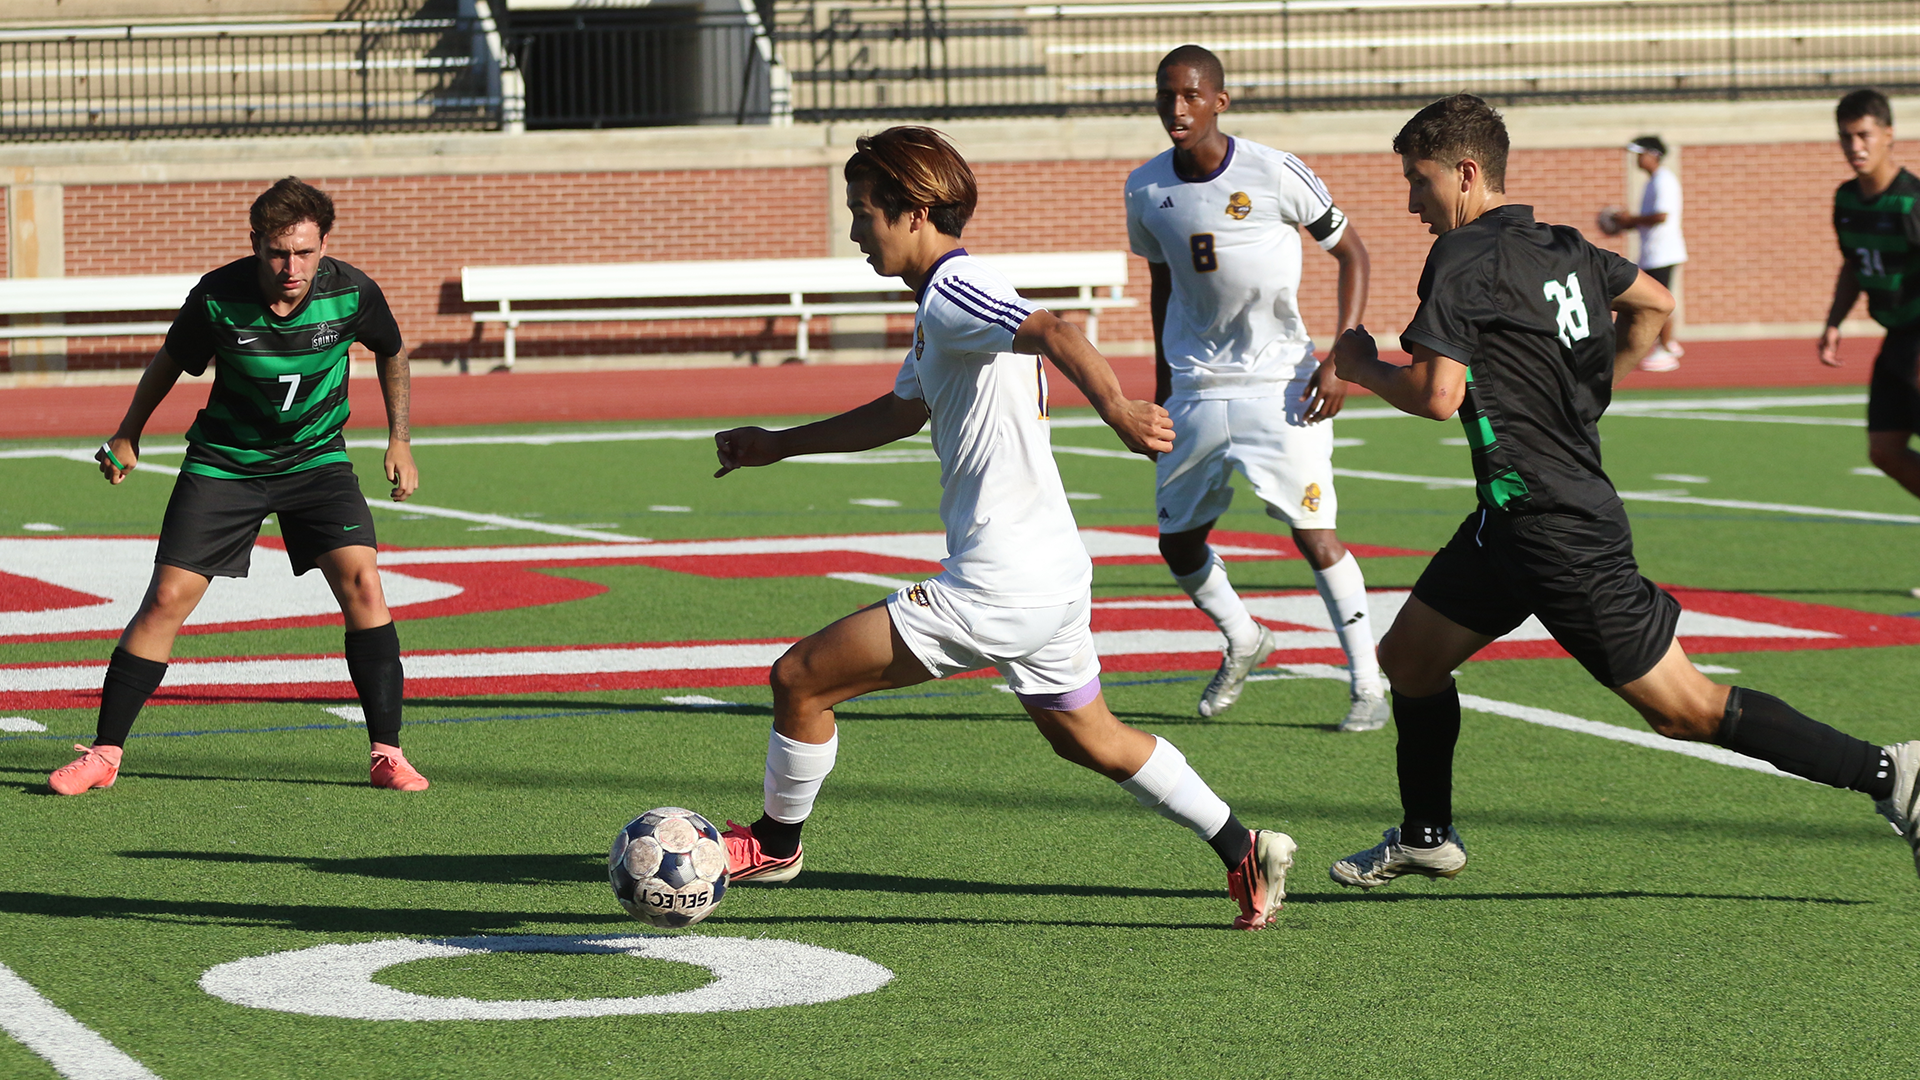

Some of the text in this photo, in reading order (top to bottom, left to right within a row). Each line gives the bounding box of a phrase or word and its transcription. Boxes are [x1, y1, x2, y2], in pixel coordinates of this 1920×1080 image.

[1190, 232, 1218, 273] 8
[313, 334, 339, 347] SAINTS
[278, 374, 302, 412] 7
[639, 888, 709, 909] SELECT
